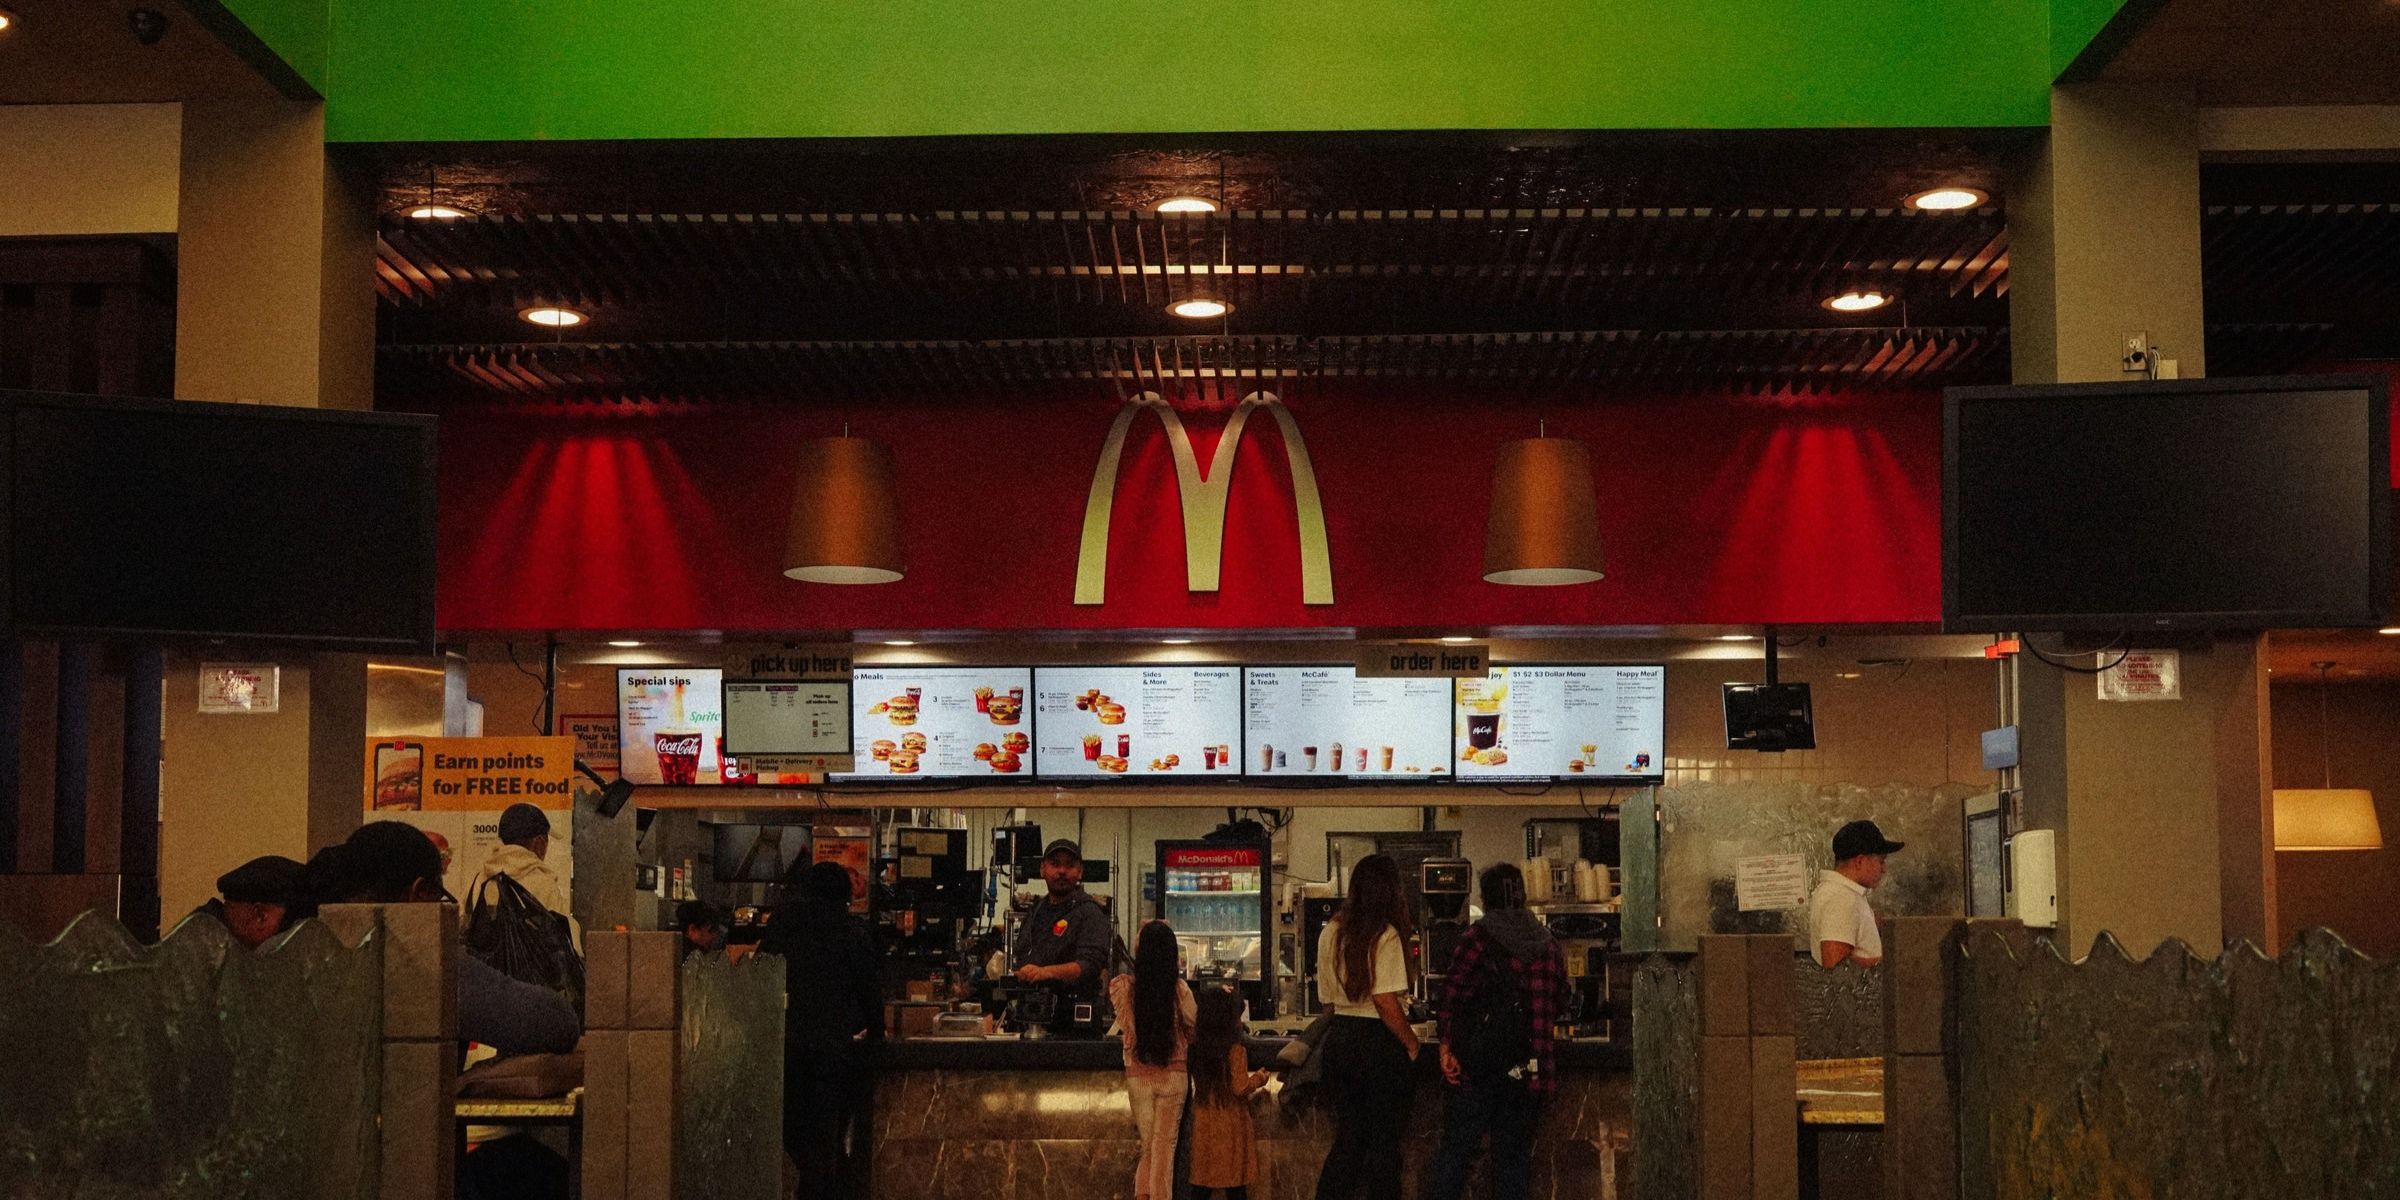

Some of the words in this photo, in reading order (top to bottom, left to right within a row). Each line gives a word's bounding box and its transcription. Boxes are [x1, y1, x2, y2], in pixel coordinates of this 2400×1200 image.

[750, 654, 786, 677] pick
[789, 657, 809, 677] up
[812, 654, 851, 672] here
[1390, 652, 1436, 671] order
[1441, 652, 1479, 671] here
[1193, 671, 1230, 679] Beverages
[1616, 670, 1640, 679] Happy
[627, 676, 667, 687] Special
[669, 676, 691, 687] sips
[932, 695, 938, 703] 3
[689, 711, 721, 723] Sprite
[591, 724, 609, 732] You
[434, 753, 479, 769] Earn
[482, 751, 545, 773] points
[432, 778, 462, 795] for
[466, 777, 522, 795] FREE
[525, 778, 569, 795] food
[472, 824, 498, 834] 3000
[1178, 855, 1233, 864] McDonald's
